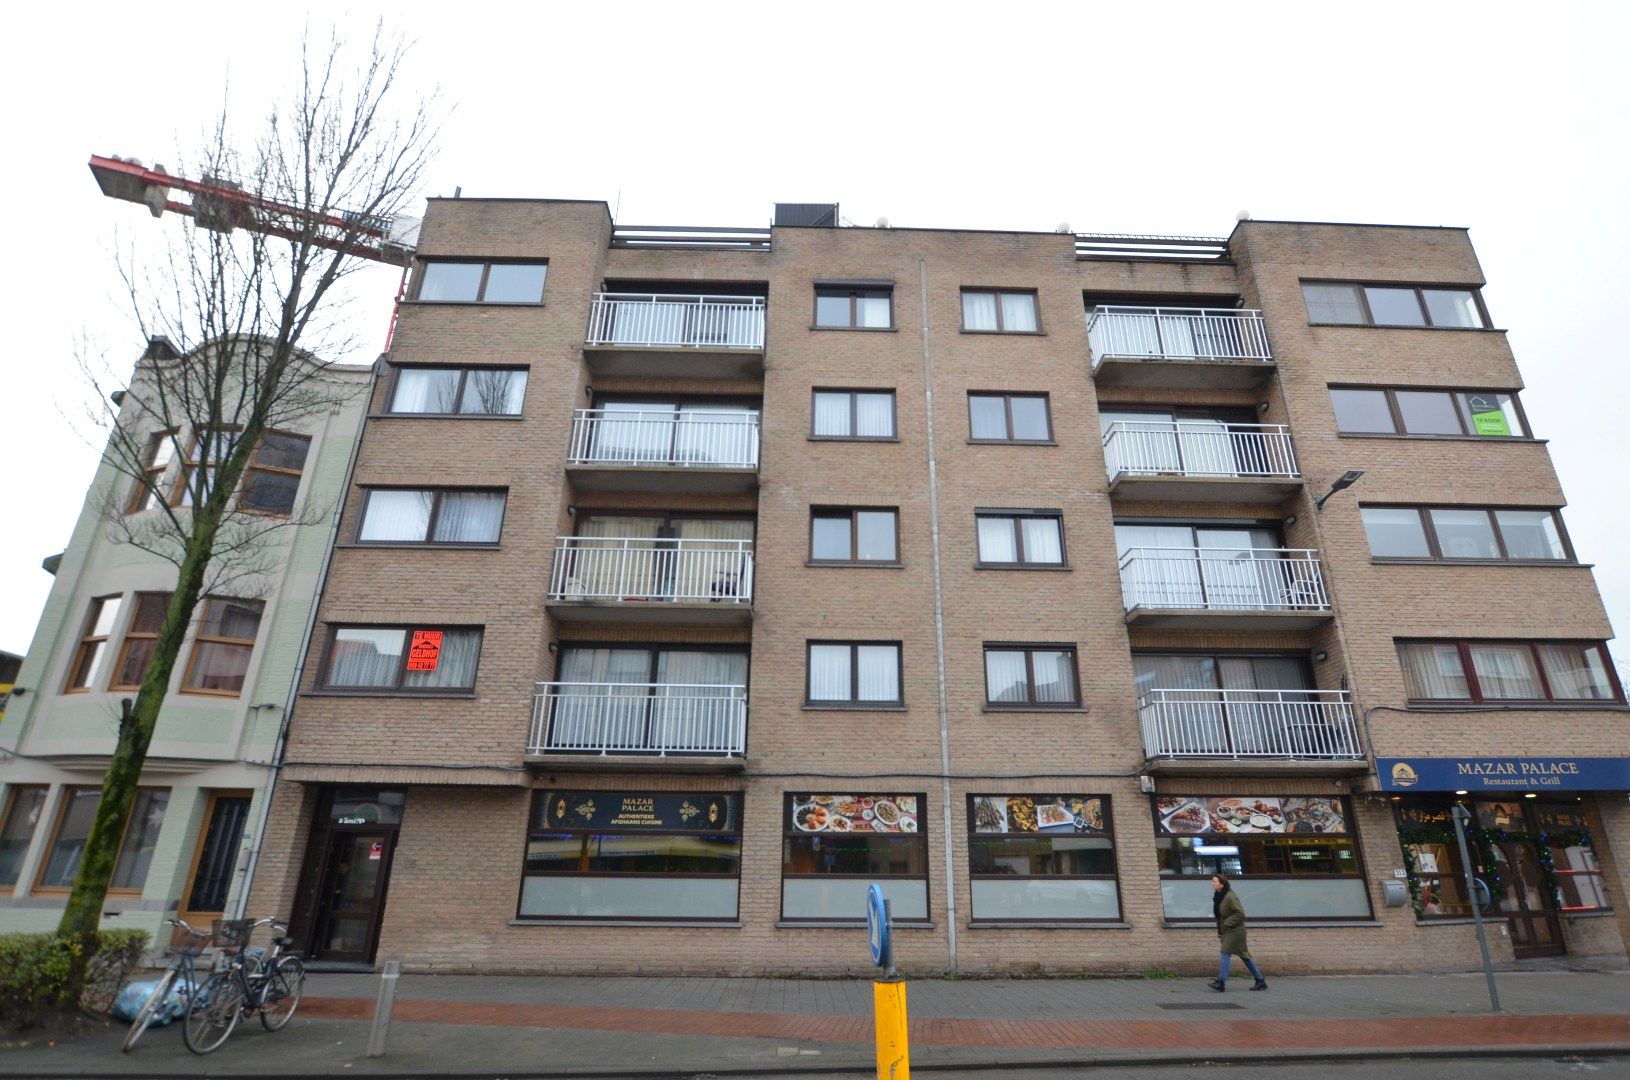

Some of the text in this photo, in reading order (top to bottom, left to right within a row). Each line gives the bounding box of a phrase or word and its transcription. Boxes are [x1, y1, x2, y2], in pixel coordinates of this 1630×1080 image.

[411, 649, 437, 658] GELDHOF
[1457, 762, 1579, 775] MAZAR PALACE
[1483, 777, 1528, 786] Restaurant
[1540, 777, 1561, 785] Grill
